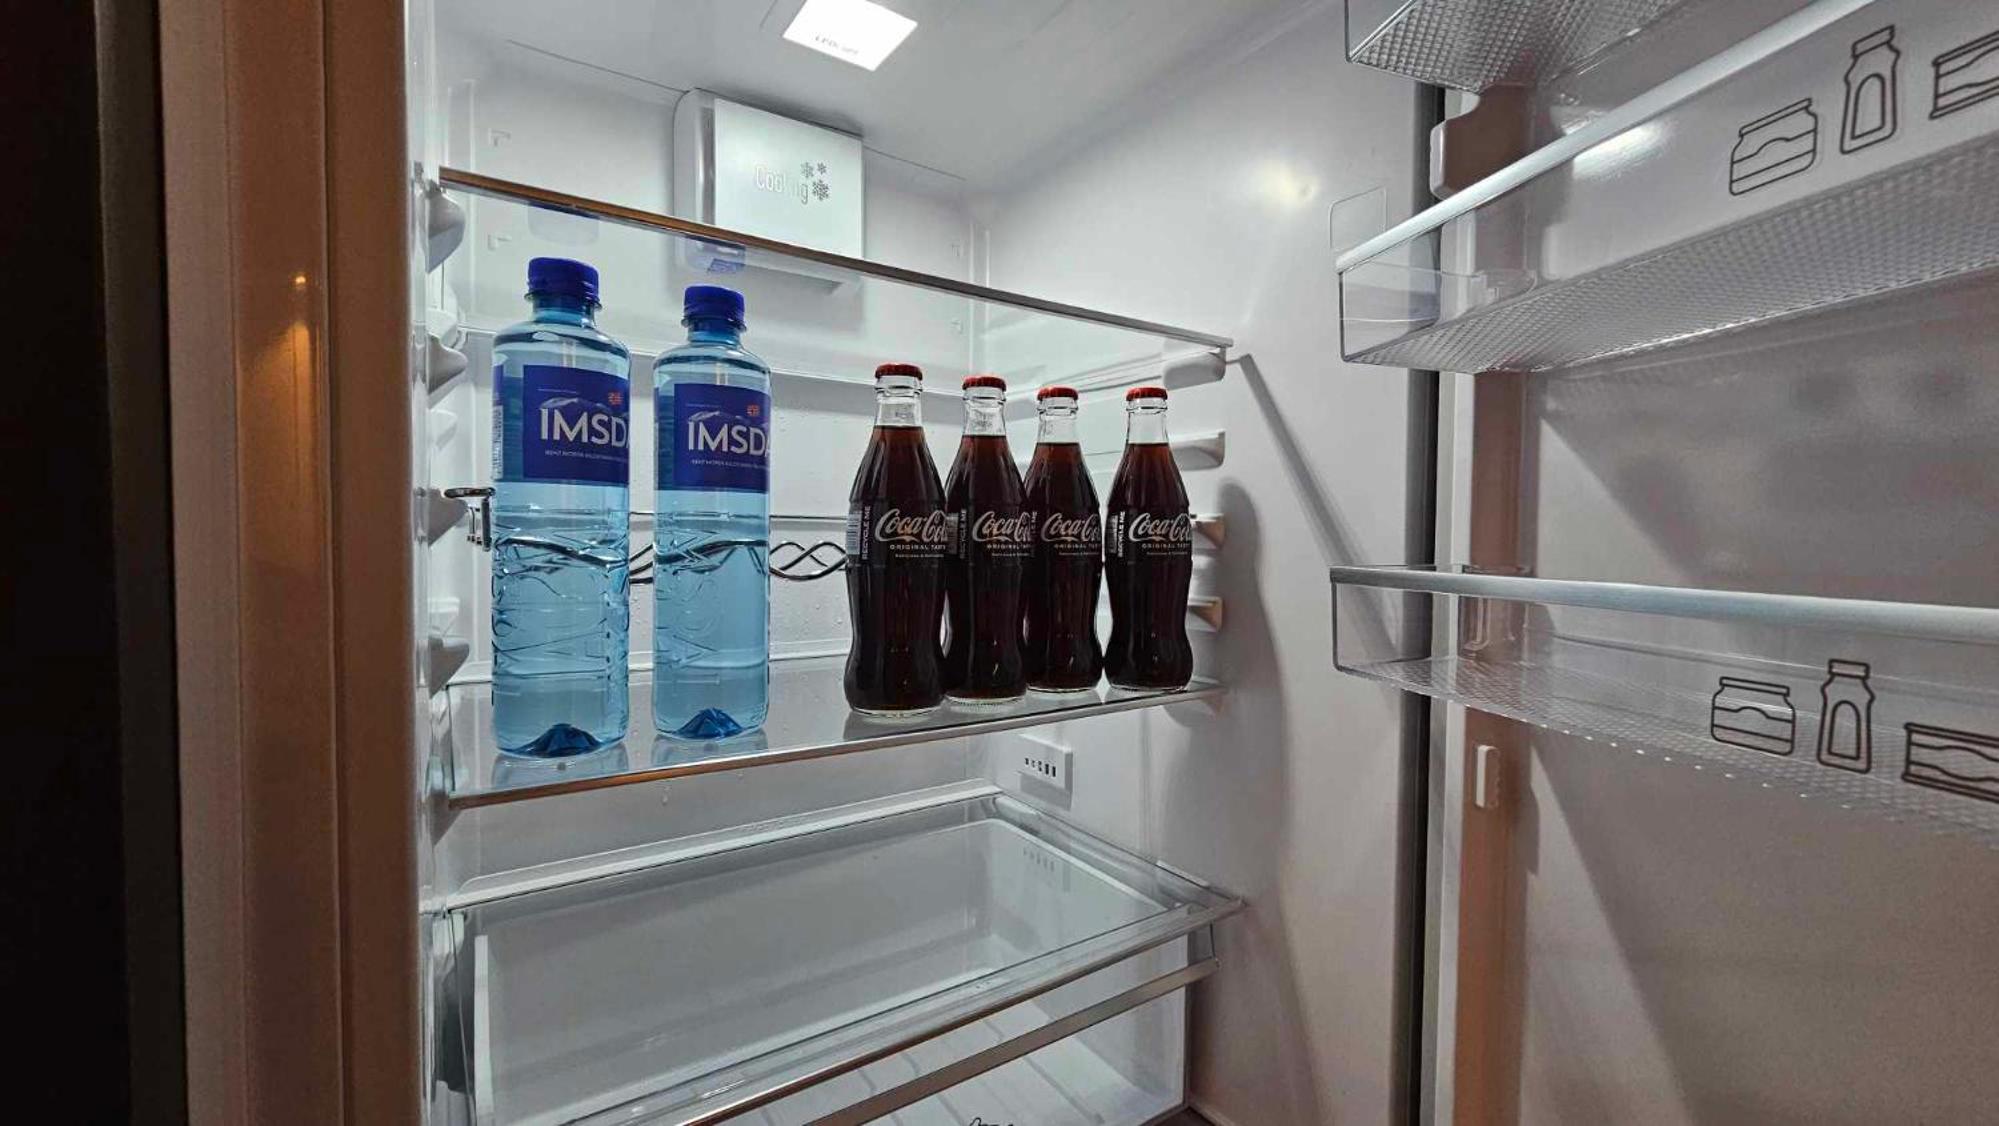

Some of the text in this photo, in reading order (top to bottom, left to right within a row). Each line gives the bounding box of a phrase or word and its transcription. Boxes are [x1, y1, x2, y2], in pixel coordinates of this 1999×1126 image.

[540, 408, 630, 449] IMSD
[864, 506, 871, 520] ME
[875, 508, 947, 542] Coca-Col
